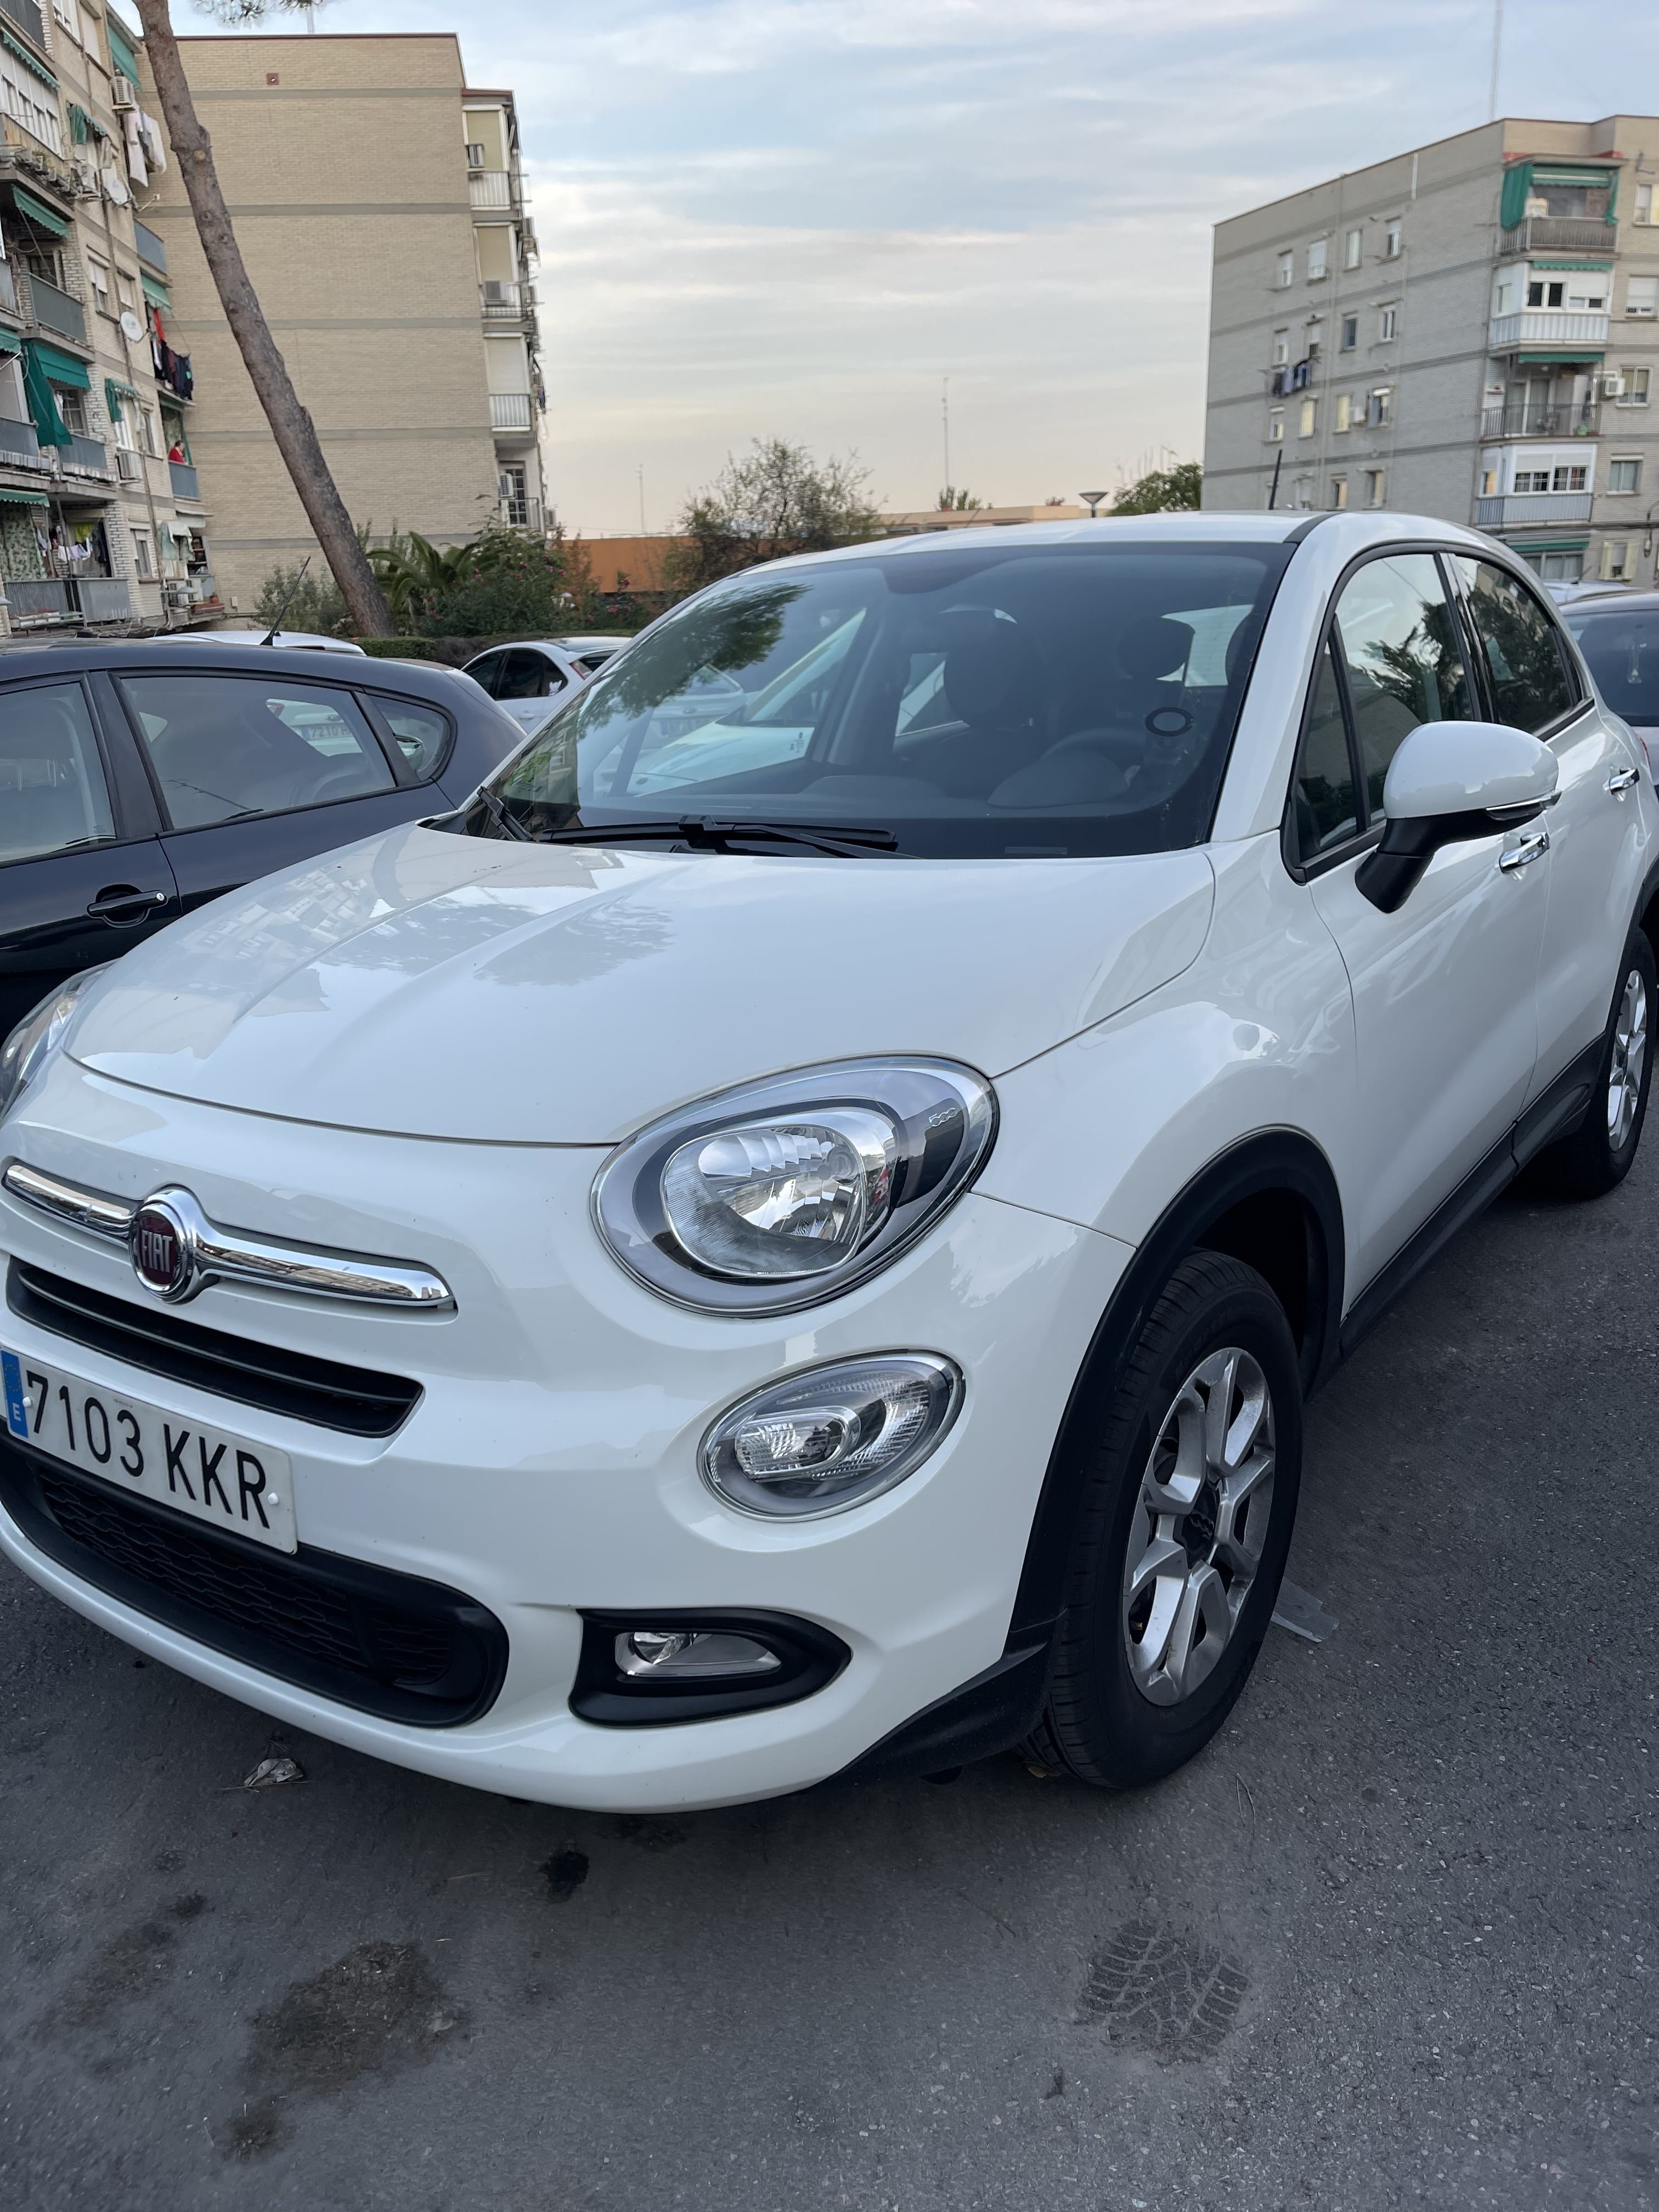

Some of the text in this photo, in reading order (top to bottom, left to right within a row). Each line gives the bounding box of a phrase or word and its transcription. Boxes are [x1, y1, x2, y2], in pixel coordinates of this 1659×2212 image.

[929, 1108, 957, 1127] 500
[142, 1230, 173, 1273] FIAT
[12, 1402, 21, 1421] E
[26, 1370, 269, 1530] 7103 KKR
